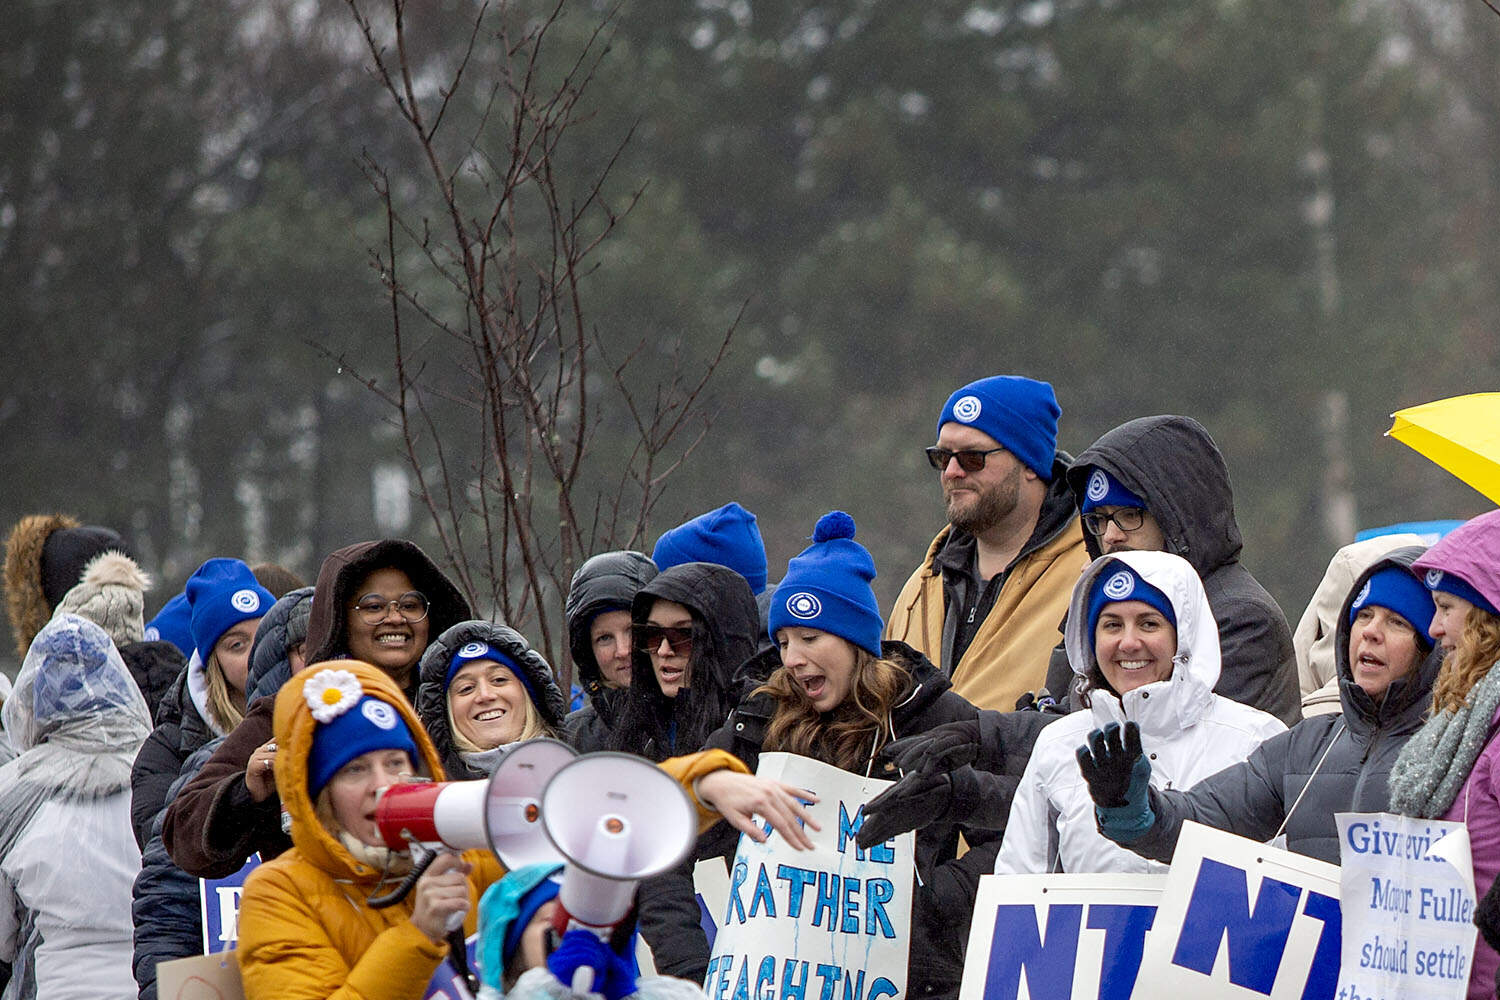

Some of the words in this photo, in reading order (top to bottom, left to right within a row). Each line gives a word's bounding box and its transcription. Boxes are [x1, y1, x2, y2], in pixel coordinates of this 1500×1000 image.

[725, 861, 896, 939] RATHER
[1360, 935, 1408, 975] should
[1415, 945, 1466, 980] settle
